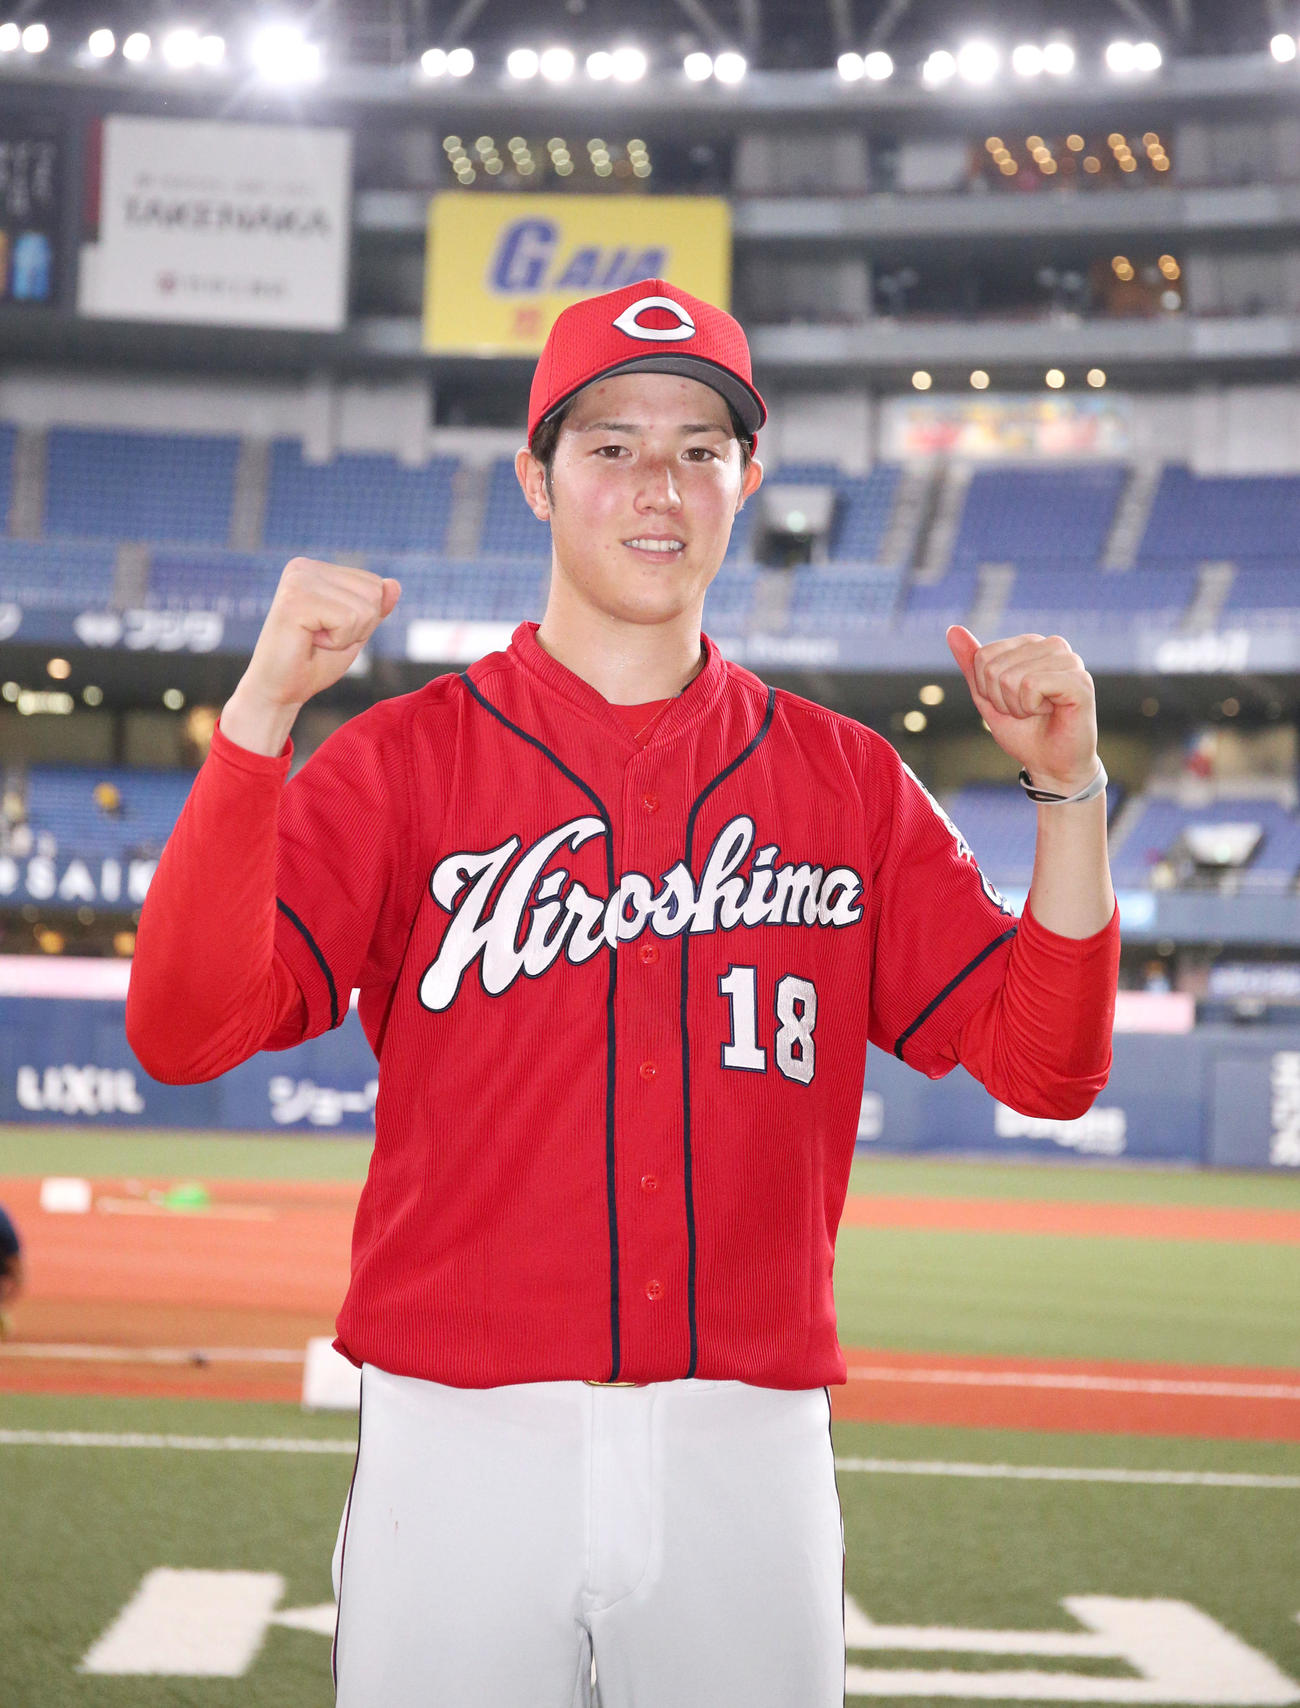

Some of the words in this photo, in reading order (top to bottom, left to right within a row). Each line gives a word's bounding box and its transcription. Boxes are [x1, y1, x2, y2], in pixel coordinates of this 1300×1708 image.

[419, 815, 864, 1013] Hiroshima
[717, 964, 818, 1086] 18
[17, 1064, 145, 1116] LIXIL
